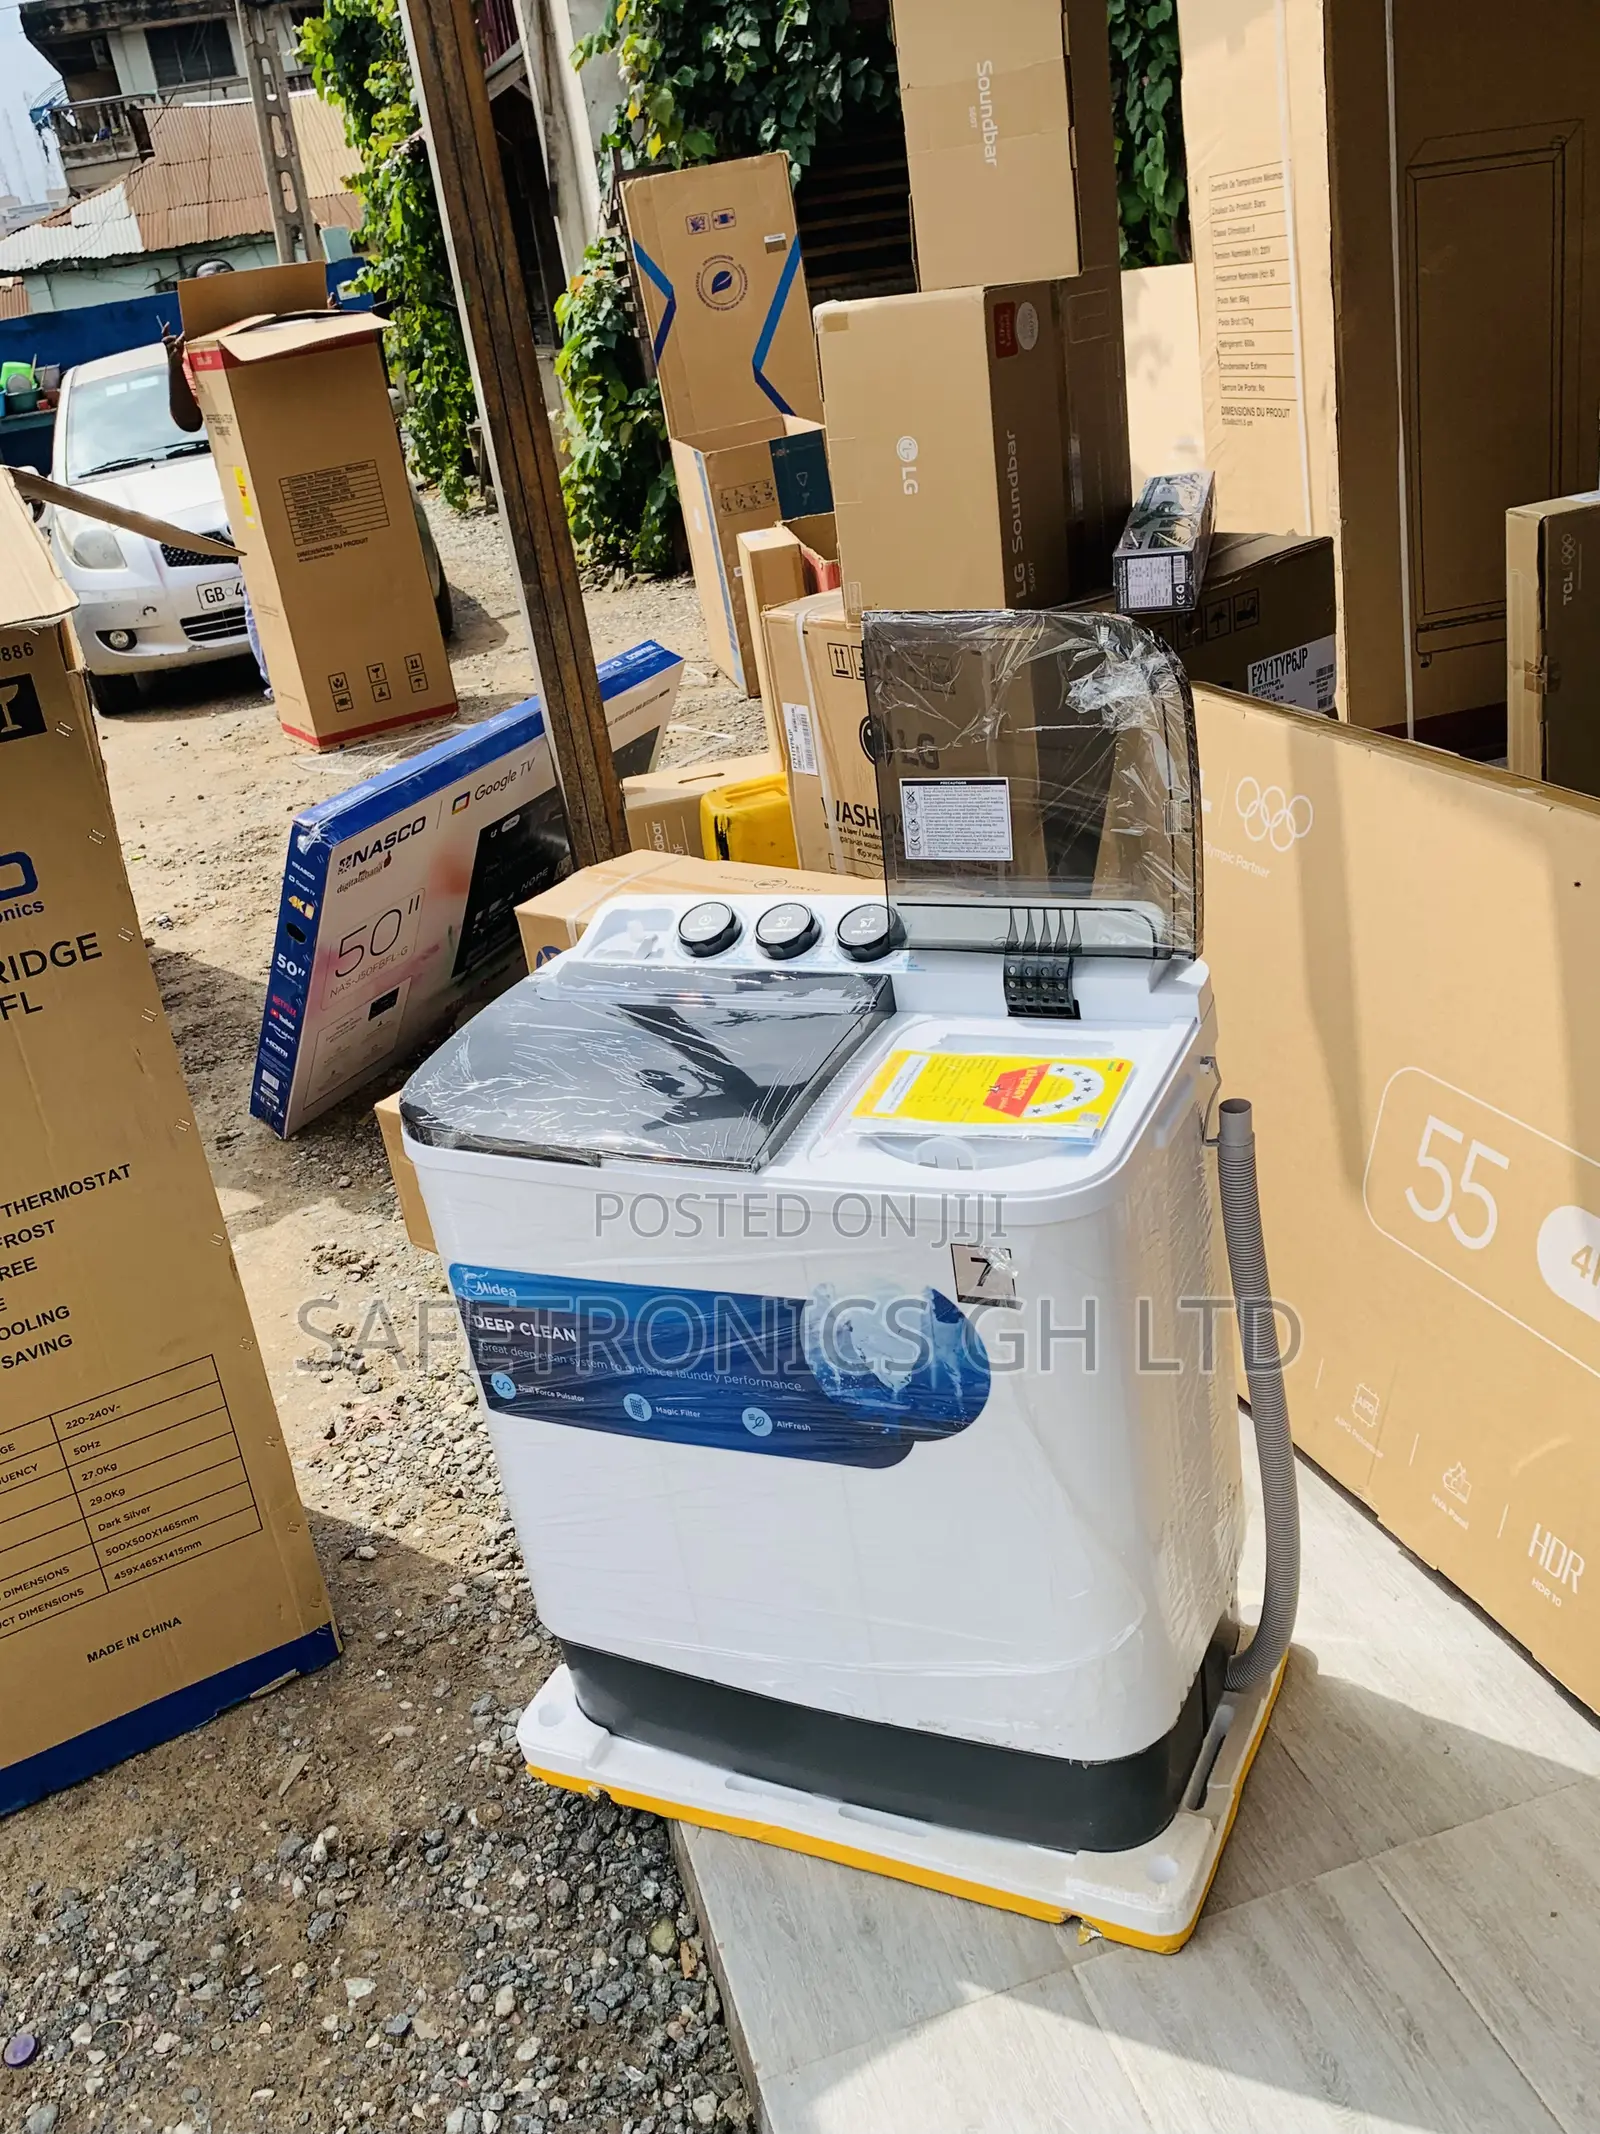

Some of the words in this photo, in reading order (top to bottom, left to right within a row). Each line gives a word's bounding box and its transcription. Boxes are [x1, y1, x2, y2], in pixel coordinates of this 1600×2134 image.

[976, 60, 998, 168] Soundbar
[902, 466, 919, 496] LG
[1006, 429, 1024, 555] Soundbar
[204, 586, 226, 603] GB
[1013, 562, 1027, 599] LG
[1562, 571, 1573, 606] TCL
[1250, 647, 1309, 687] F2Y1TYP6JP
[475, 769, 517, 801] Google
[520, 757, 536, 775] TV
[350, 815, 427, 868] NASCO
[1236, 854, 1271, 879] Partner
[265, 1036, 289, 1059] HDMI
[0, 1163, 131, 1218] THERMOSTAT
[1404, 1114, 1510, 1250] 55
[0, 1219, 56, 1249] ROST
[1571, 1244, 1600, 1287] 4
[469, 1280, 518, 1299] Midea
[473, 1314, 515, 1333] DEEP
[519, 1321, 577, 1343] CLEAN
[1, 1334, 73, 1370] SAVING
[481, 1340, 508, 1355] Great
[510, 1346, 537, 1361] deep
[539, 1350, 567, 1365] clean
[569, 1356, 608, 1371] system
[610, 1360, 622, 1372] to
[624, 1363, 672, 1379] enhance
[676, 1368, 720, 1386] laundry
[724, 1374, 806, 1393] performance.
[535, 1386, 556, 1398] Force
[556, 1391, 585, 1403] Pulsator
[655, 1406, 679, 1418] Magic
[680, 1408, 701, 1419] Filter
[776, 1420, 811, 1432] AirFresh
[73, 1439, 102, 1457] 50Hz
[81, 1462, 118, 1482] 27.0Kg
[89, 1487, 126, 1508] 29.0Kg
[98, 1517, 122, 1533] Dark
[123, 1504, 152, 1524] Silver
[105, 1513, 200, 1557] 500X500X1465mm
[114, 1540, 203, 1581] 459X465X1415mm
[1528, 1521, 1586, 1594] HDR
[3, 1565, 70, 1599] DIMENSIONS
[1531, 1576, 1551, 1599] HDR
[18, 1587, 85, 1622] DIMENSIONS
[86, 1639, 125, 1664] MADE
[126, 1632, 140, 1647] IN
[142, 1616, 182, 1641] CHINA
